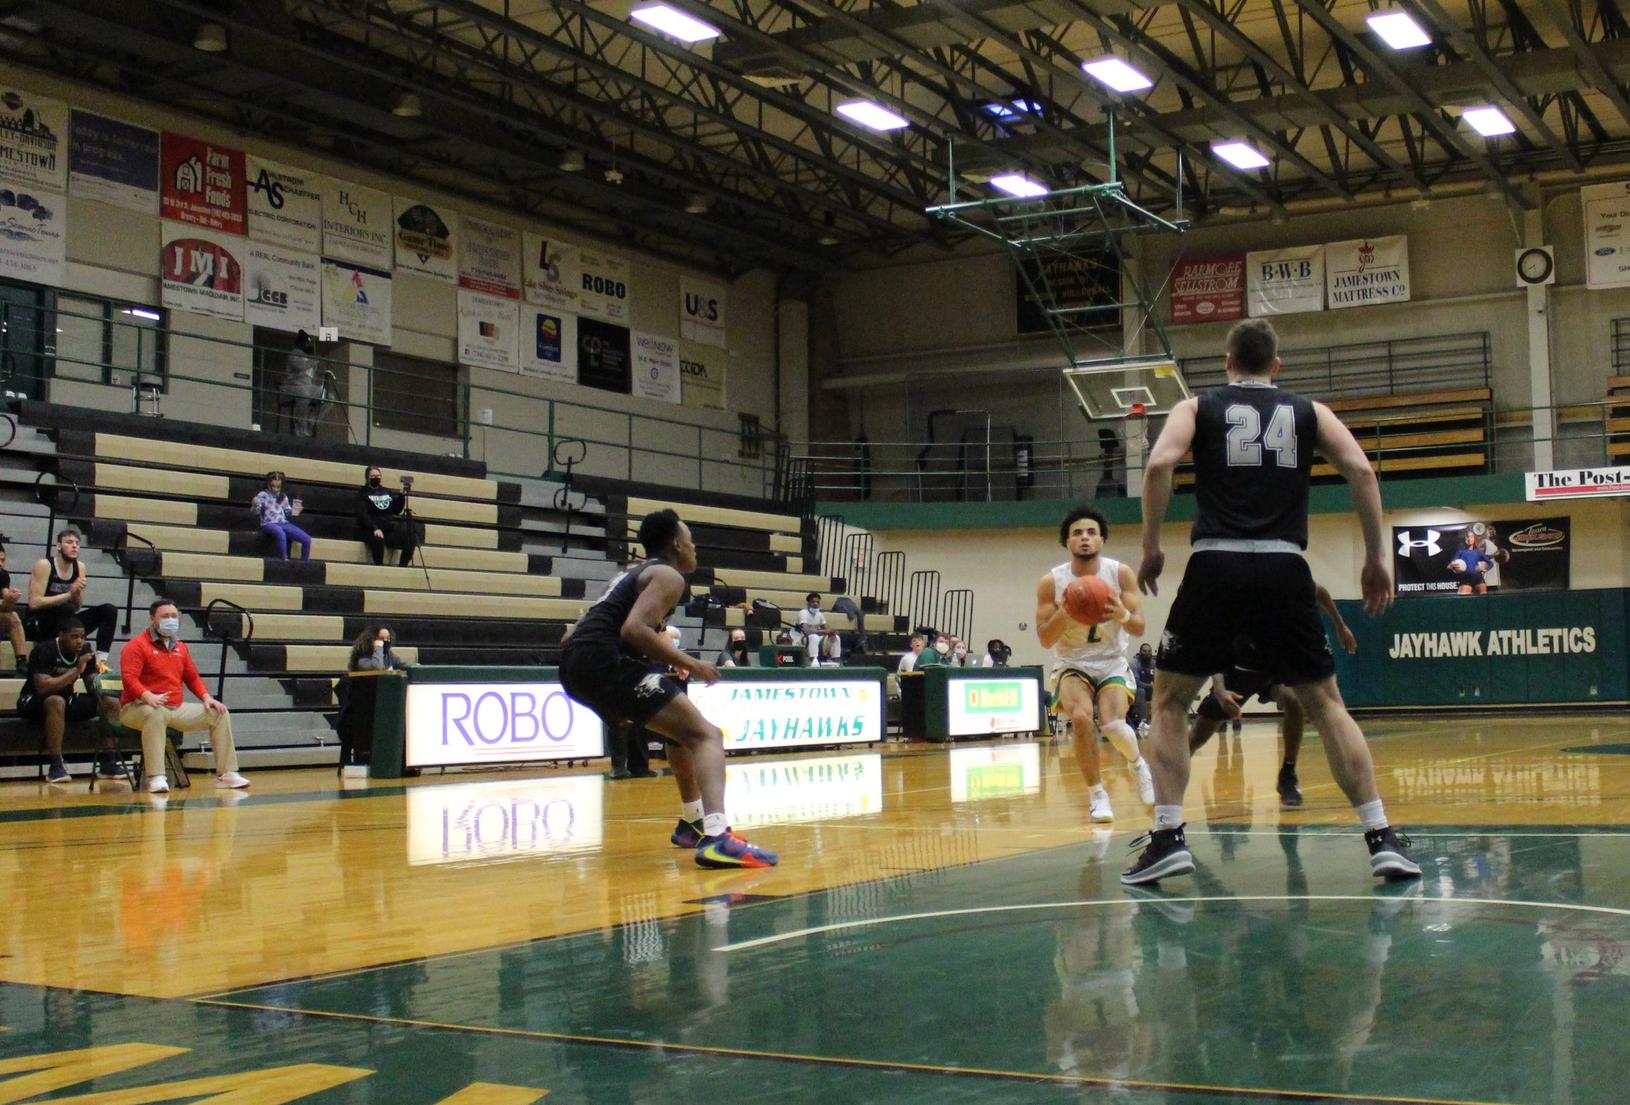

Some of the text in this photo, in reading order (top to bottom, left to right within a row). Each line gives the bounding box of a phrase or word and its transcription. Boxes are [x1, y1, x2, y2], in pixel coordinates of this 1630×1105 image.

[206, 146, 230, 169] Farm
[206, 165, 232, 190] Fresh
[206, 185, 231, 208] Foods
[323, 219, 370, 241] INTERIORS
[582, 272, 627, 300] ROBO
[1334, 269, 1401, 289] JAMESTOWN
[1332, 287, 1389, 304] MATTRESS
[1225, 404, 1298, 469] 24
[1534, 473, 1572, 488] The
[1398, 583, 1425, 592] PROTECT
[1426, 582, 1437, 591] THIS
[1389, 626, 1597, 660] JAYHAWK ATHLETICS
[730, 686, 853, 701] JAMESTOWN
[440, 690, 574, 747] ROBO
[736, 715, 866, 742] JAYHAWKS
